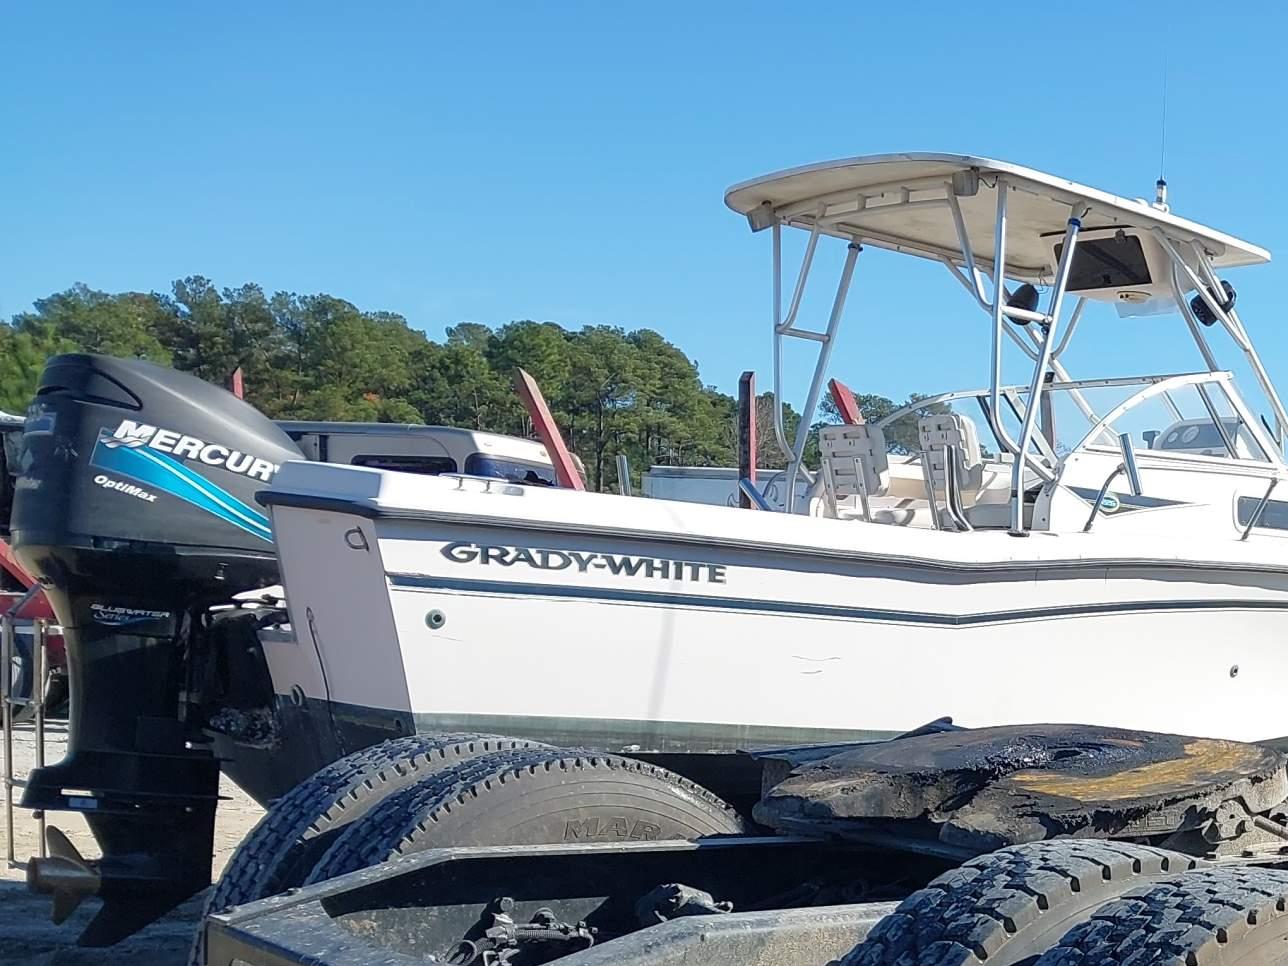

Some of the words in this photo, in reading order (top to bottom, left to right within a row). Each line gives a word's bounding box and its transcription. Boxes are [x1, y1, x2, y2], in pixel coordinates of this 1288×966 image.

[112, 420, 279, 483] MERCUR
[93, 474, 157, 503] OptiMax
[440, 540, 727, 584] GRADY-WHITE
